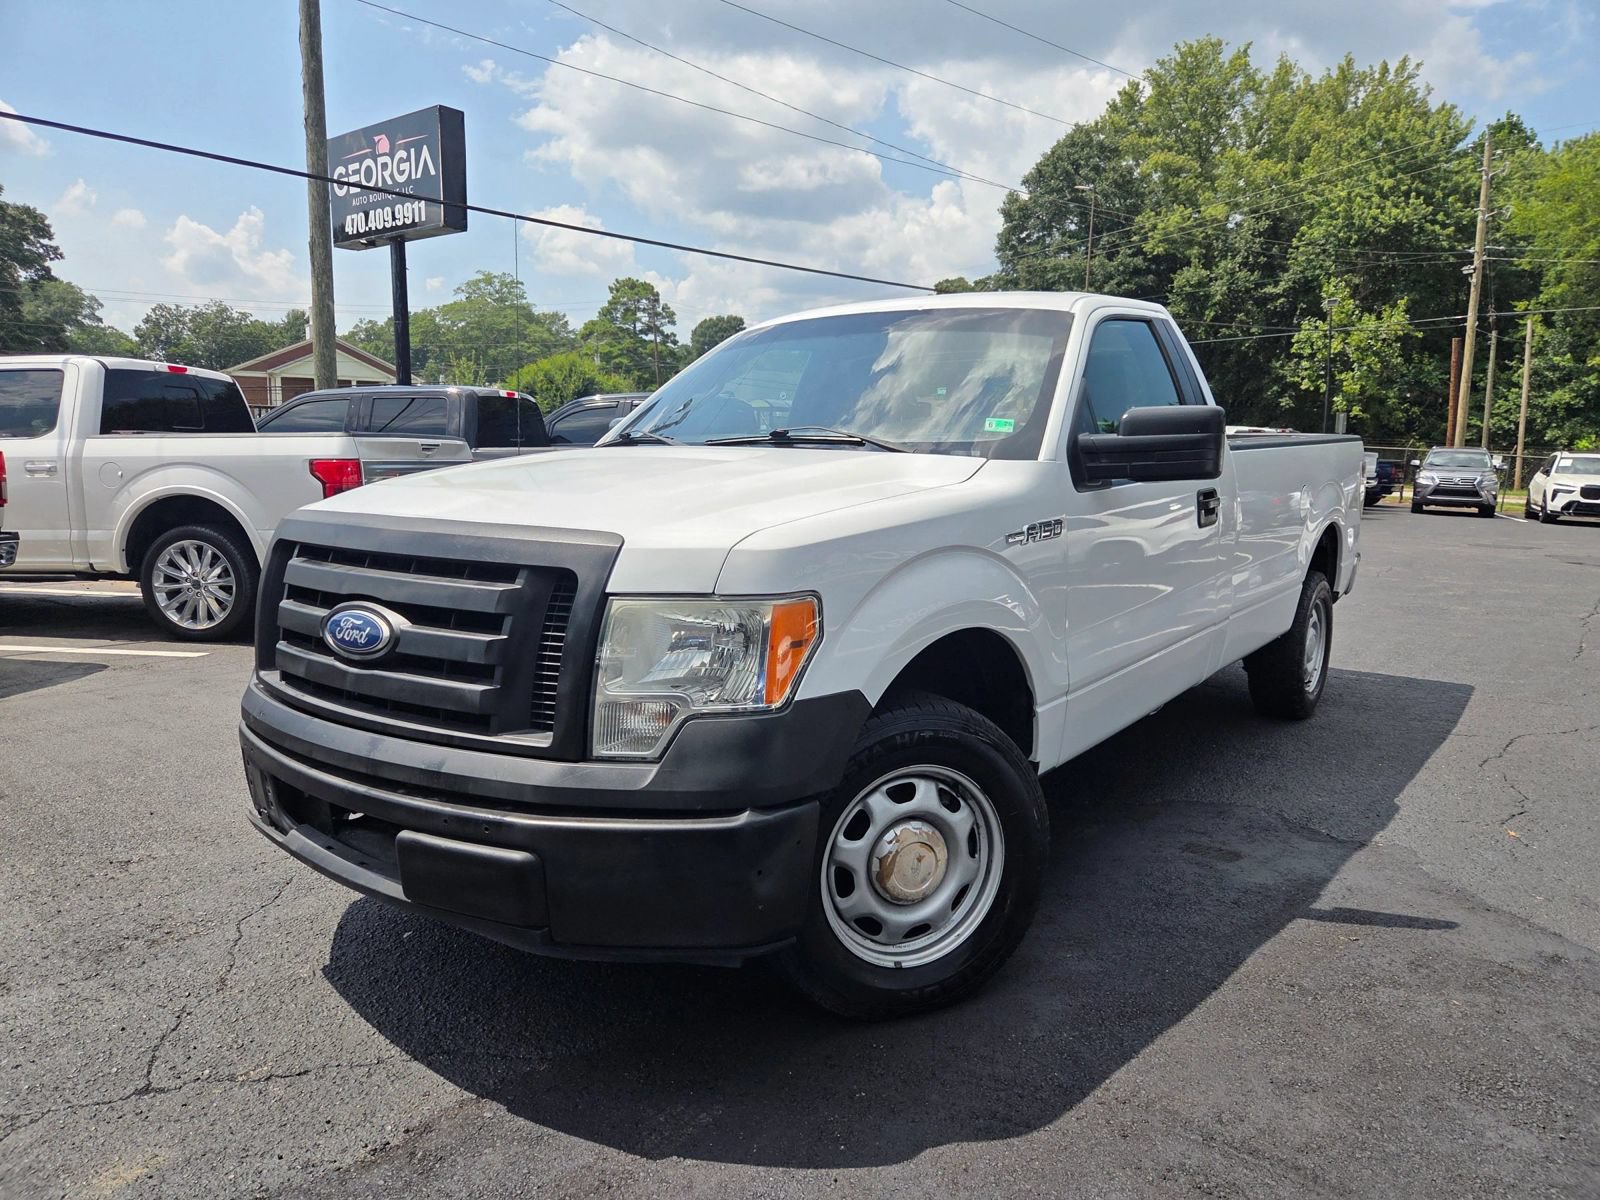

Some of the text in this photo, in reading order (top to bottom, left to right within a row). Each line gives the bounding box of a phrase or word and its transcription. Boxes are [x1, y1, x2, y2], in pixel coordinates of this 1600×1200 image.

[333, 144, 436, 197] GEORGIA
[352, 195, 368, 206] AUTO
[369, 188, 400, 203] BOUTIQ
[344, 200, 426, 235] 470.409.9911
[335, 616, 371, 644] Ford
